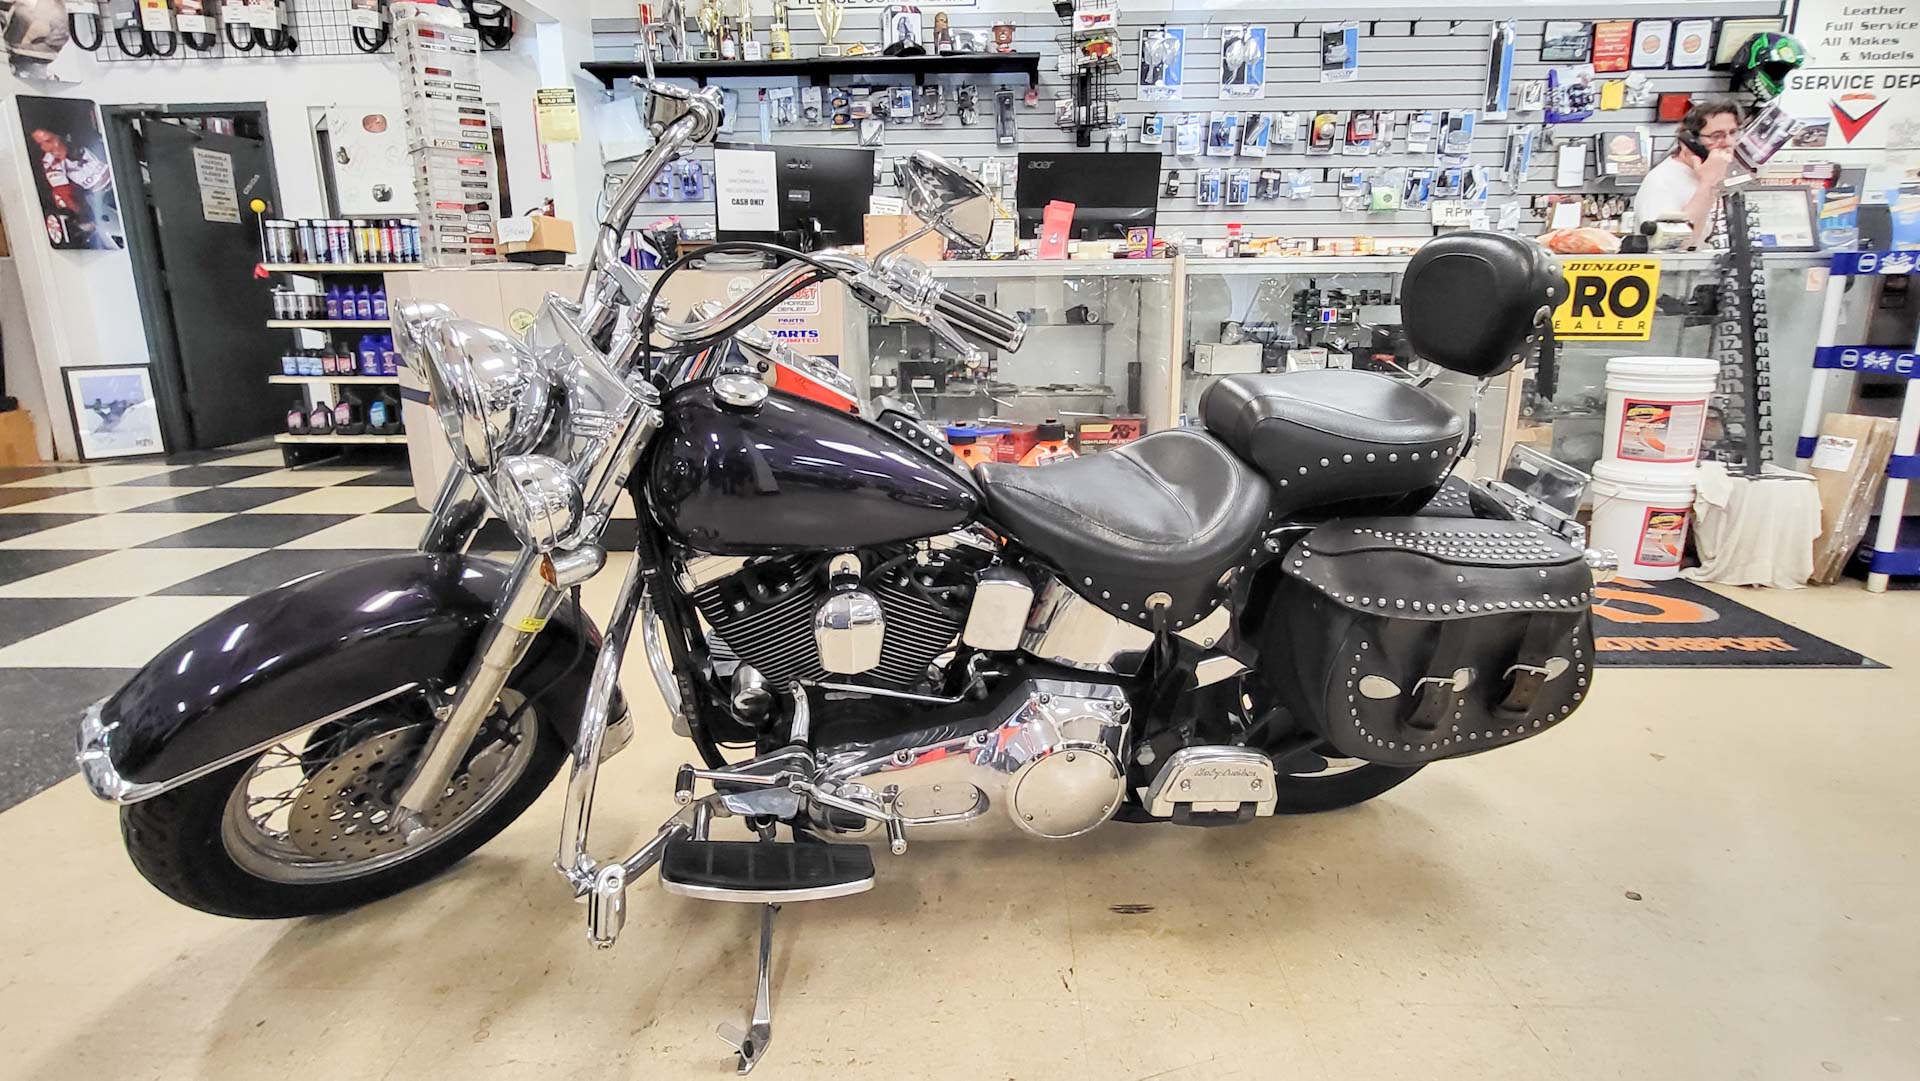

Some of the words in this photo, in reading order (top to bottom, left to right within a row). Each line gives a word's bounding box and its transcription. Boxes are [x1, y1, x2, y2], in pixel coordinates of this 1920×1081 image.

[1843, 6, 1906, 16] Leather
[1825, 21, 1854, 31] Full
[1861, 20, 1920, 31] Service
[1821, 37, 1842, 47] All
[1849, 36, 1900, 46] Makes
[1840, 52, 1851, 61] &
[1860, 51, 1915, 61] Models
[1791, 75, 1875, 90] SERVICE
[1882, 74, 1920, 89] DEP
[1028, 160, 1055, 170] acer
[731, 198, 748, 206] CASH
[749, 198, 765, 206] ONLY
[1567, 263, 1641, 272] DUNLOP
[1553, 320, 1646, 330] EALER
[768, 329, 819, 338] PARTS
